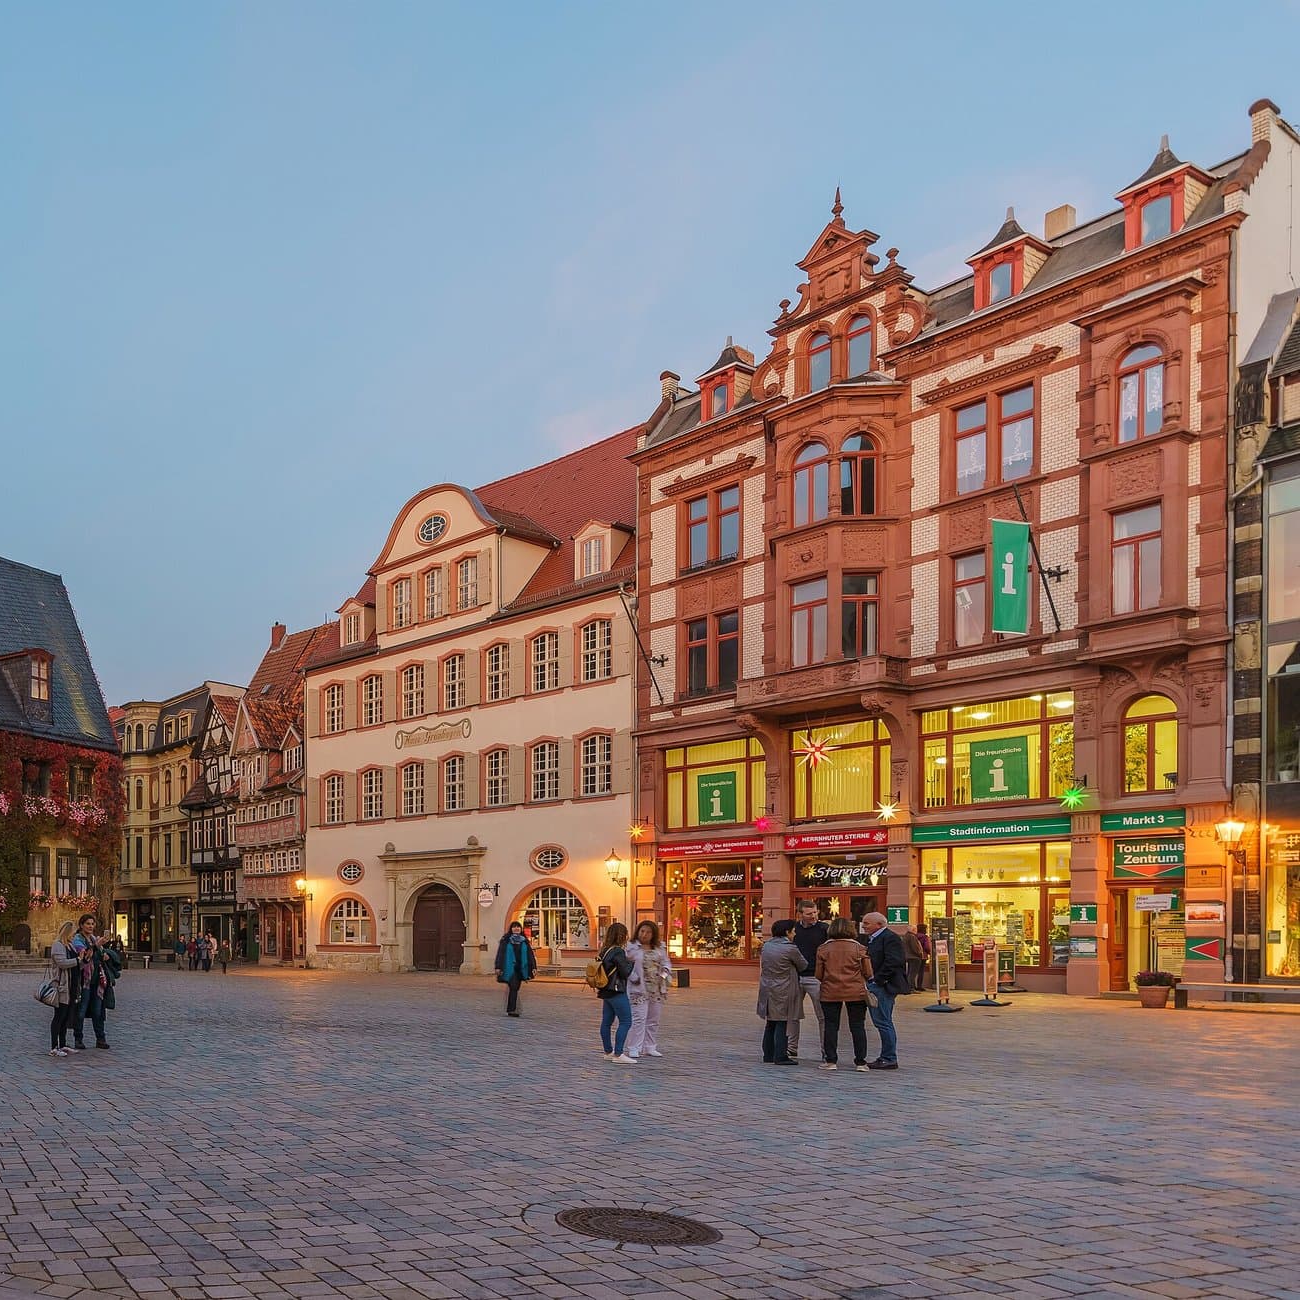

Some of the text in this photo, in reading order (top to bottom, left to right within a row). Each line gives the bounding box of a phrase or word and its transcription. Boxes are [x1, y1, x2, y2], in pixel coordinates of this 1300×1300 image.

[986, 747, 1022, 756] freundliche
[1122, 814, 1165, 826] Markt 3
[949, 824, 1030, 836] Stadtinformation
[802, 832, 871, 843] HERRNHUTER STERNE
[1116, 842, 1185, 853] Tourismus
[1123, 854, 1179, 864] Zentrum
[697, 872, 744, 883] Sternehaus
